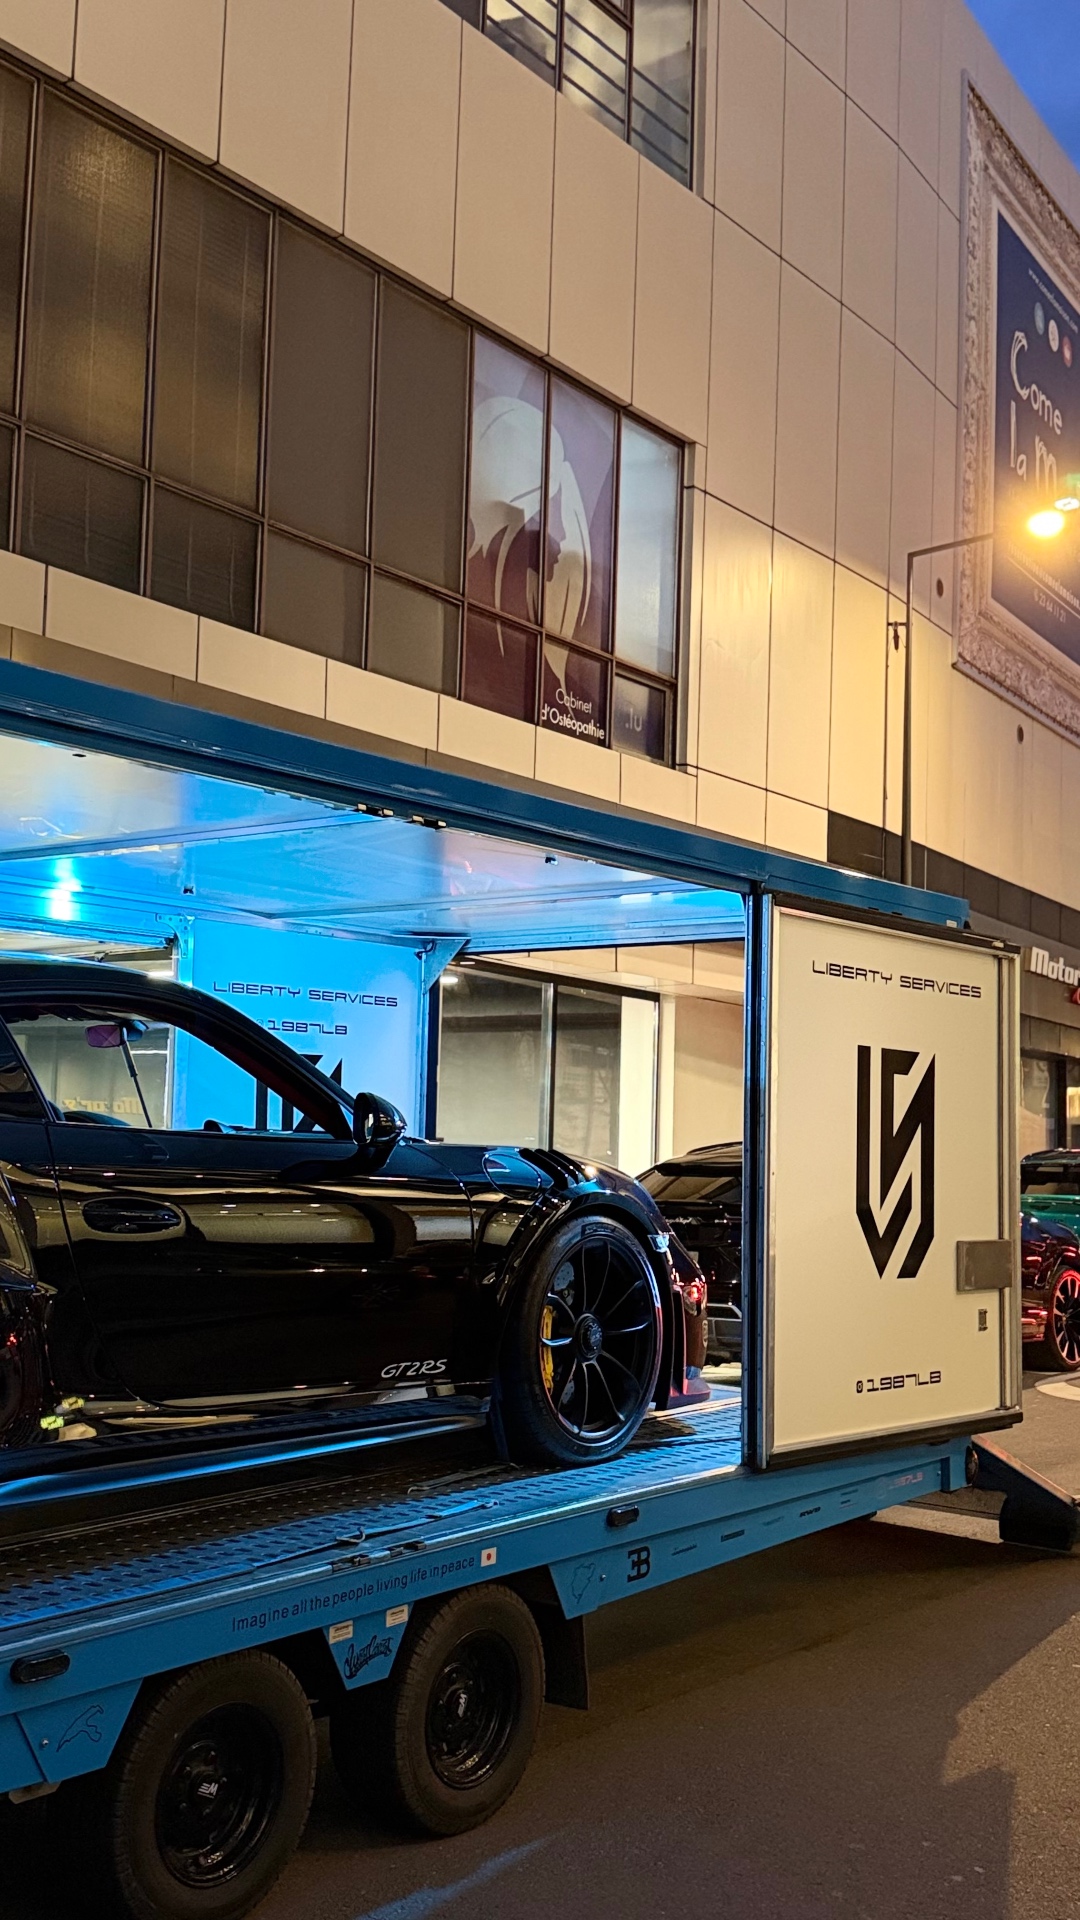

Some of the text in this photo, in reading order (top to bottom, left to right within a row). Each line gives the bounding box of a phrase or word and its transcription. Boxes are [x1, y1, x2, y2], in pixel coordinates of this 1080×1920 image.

[1010, 330, 1063, 435] Come
[555, 688, 592, 714] Cabinet
[541, 703, 605, 739] d'Ostéopathie
[213, 981, 398, 1007] LIBERTY SERVICES
[812, 960, 982, 998] LIBERTY SERVICES
[232, 1557, 475, 1632] Imagine all the people living life in peace
